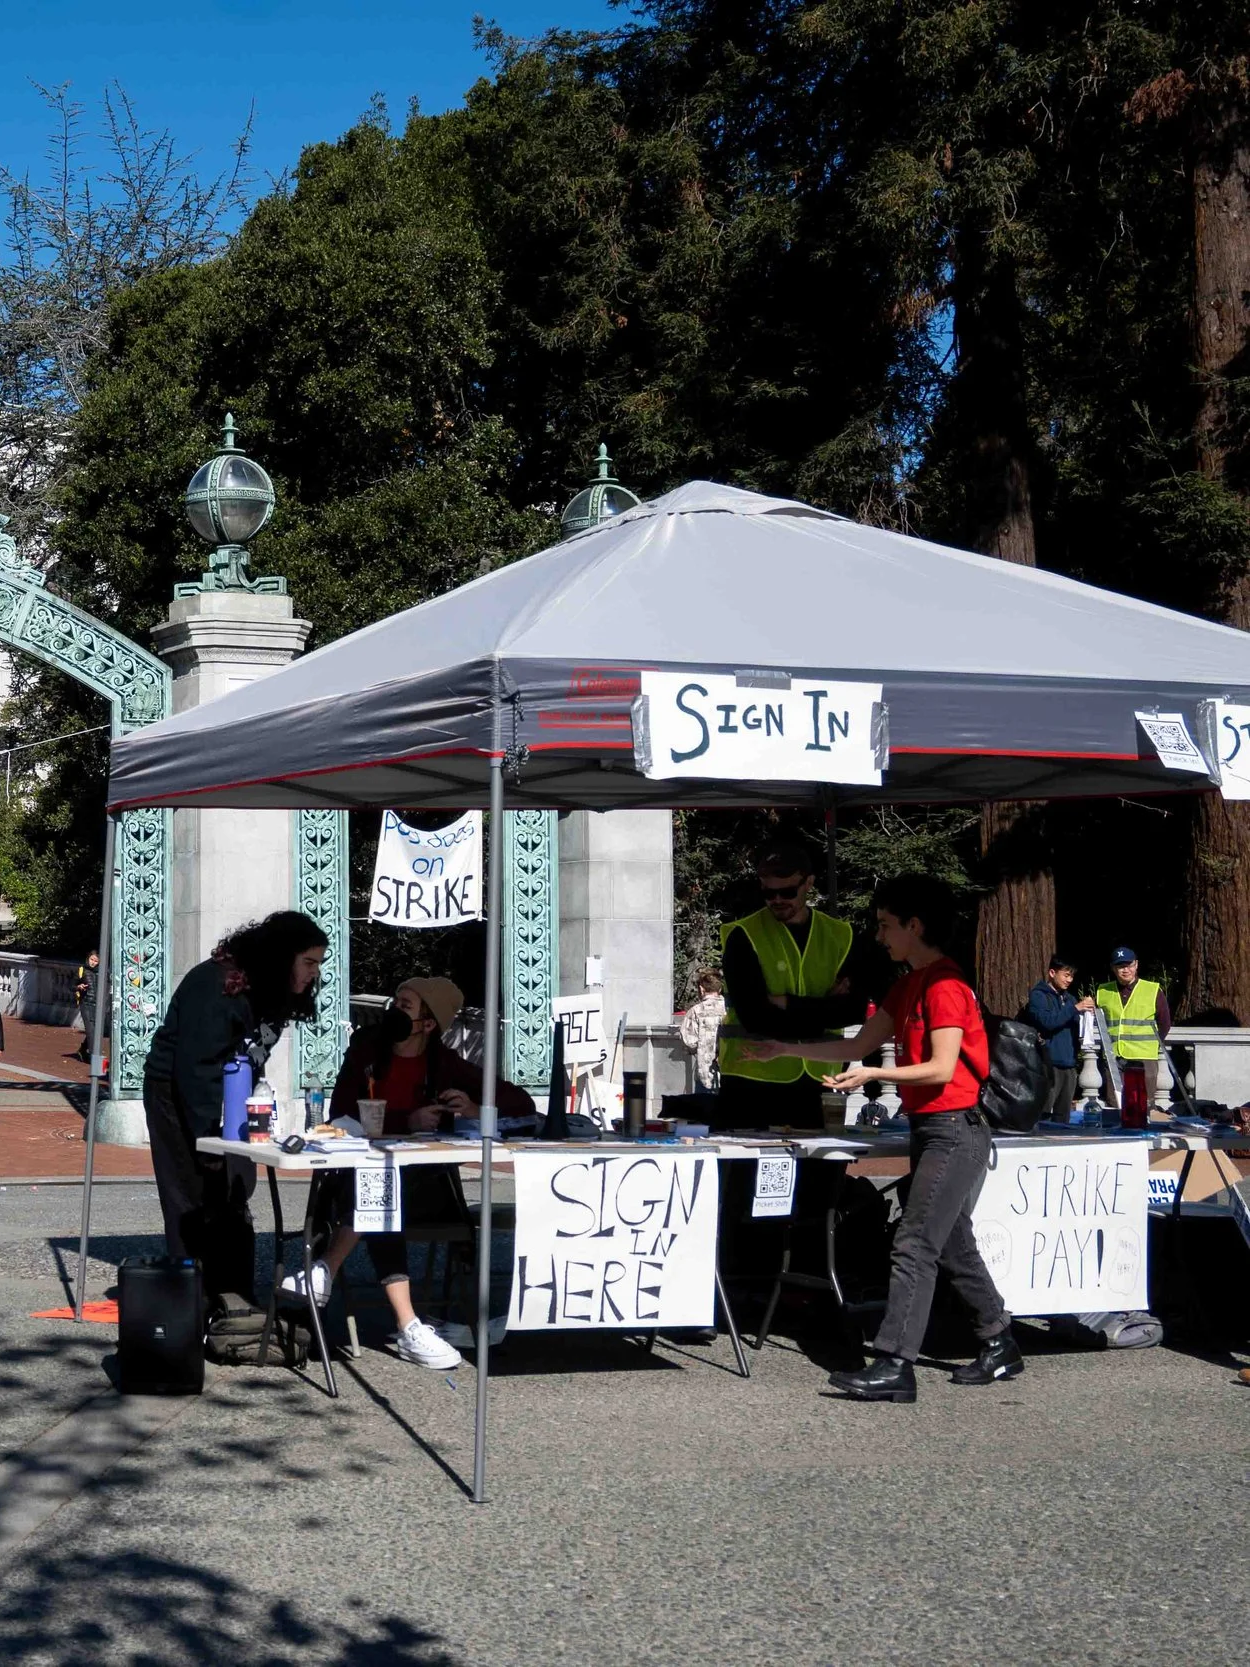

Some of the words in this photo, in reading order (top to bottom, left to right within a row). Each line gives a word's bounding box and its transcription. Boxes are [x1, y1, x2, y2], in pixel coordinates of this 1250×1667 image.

[670, 683, 784, 764] SIGN
[803, 690, 850, 752] IN
[412, 856, 444, 878] on
[373, 874, 476, 920] STRIKE
[358, 1214, 383, 1224] Check
[551, 1156, 705, 1238] SIGN
[629, 1228, 678, 1258] IN
[1031, 1228, 1104, 1289] PAY!
[518, 1254, 664, 1324] HERE
